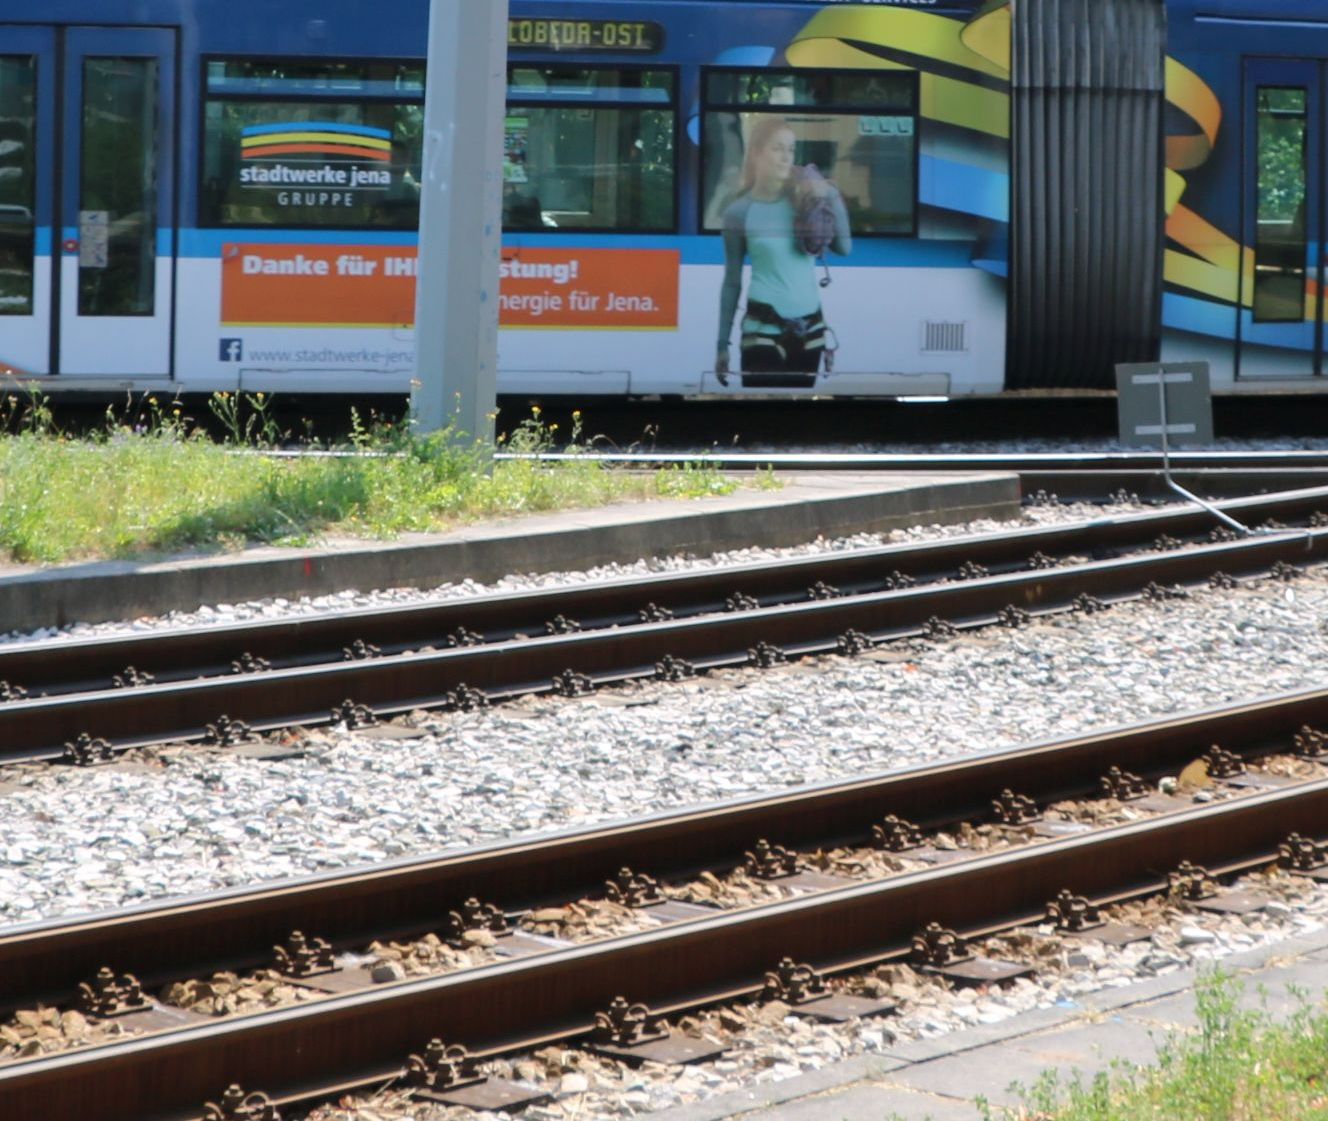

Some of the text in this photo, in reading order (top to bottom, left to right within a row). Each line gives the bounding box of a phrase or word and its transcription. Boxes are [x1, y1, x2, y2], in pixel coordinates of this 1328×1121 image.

[240, 164, 391, 188] stadtwerke jena
[277, 191, 354, 207] GRUPPE
[242, 254, 579, 284] Danke für IH stung!
[498, 290, 660, 316] nergie für Jena.
